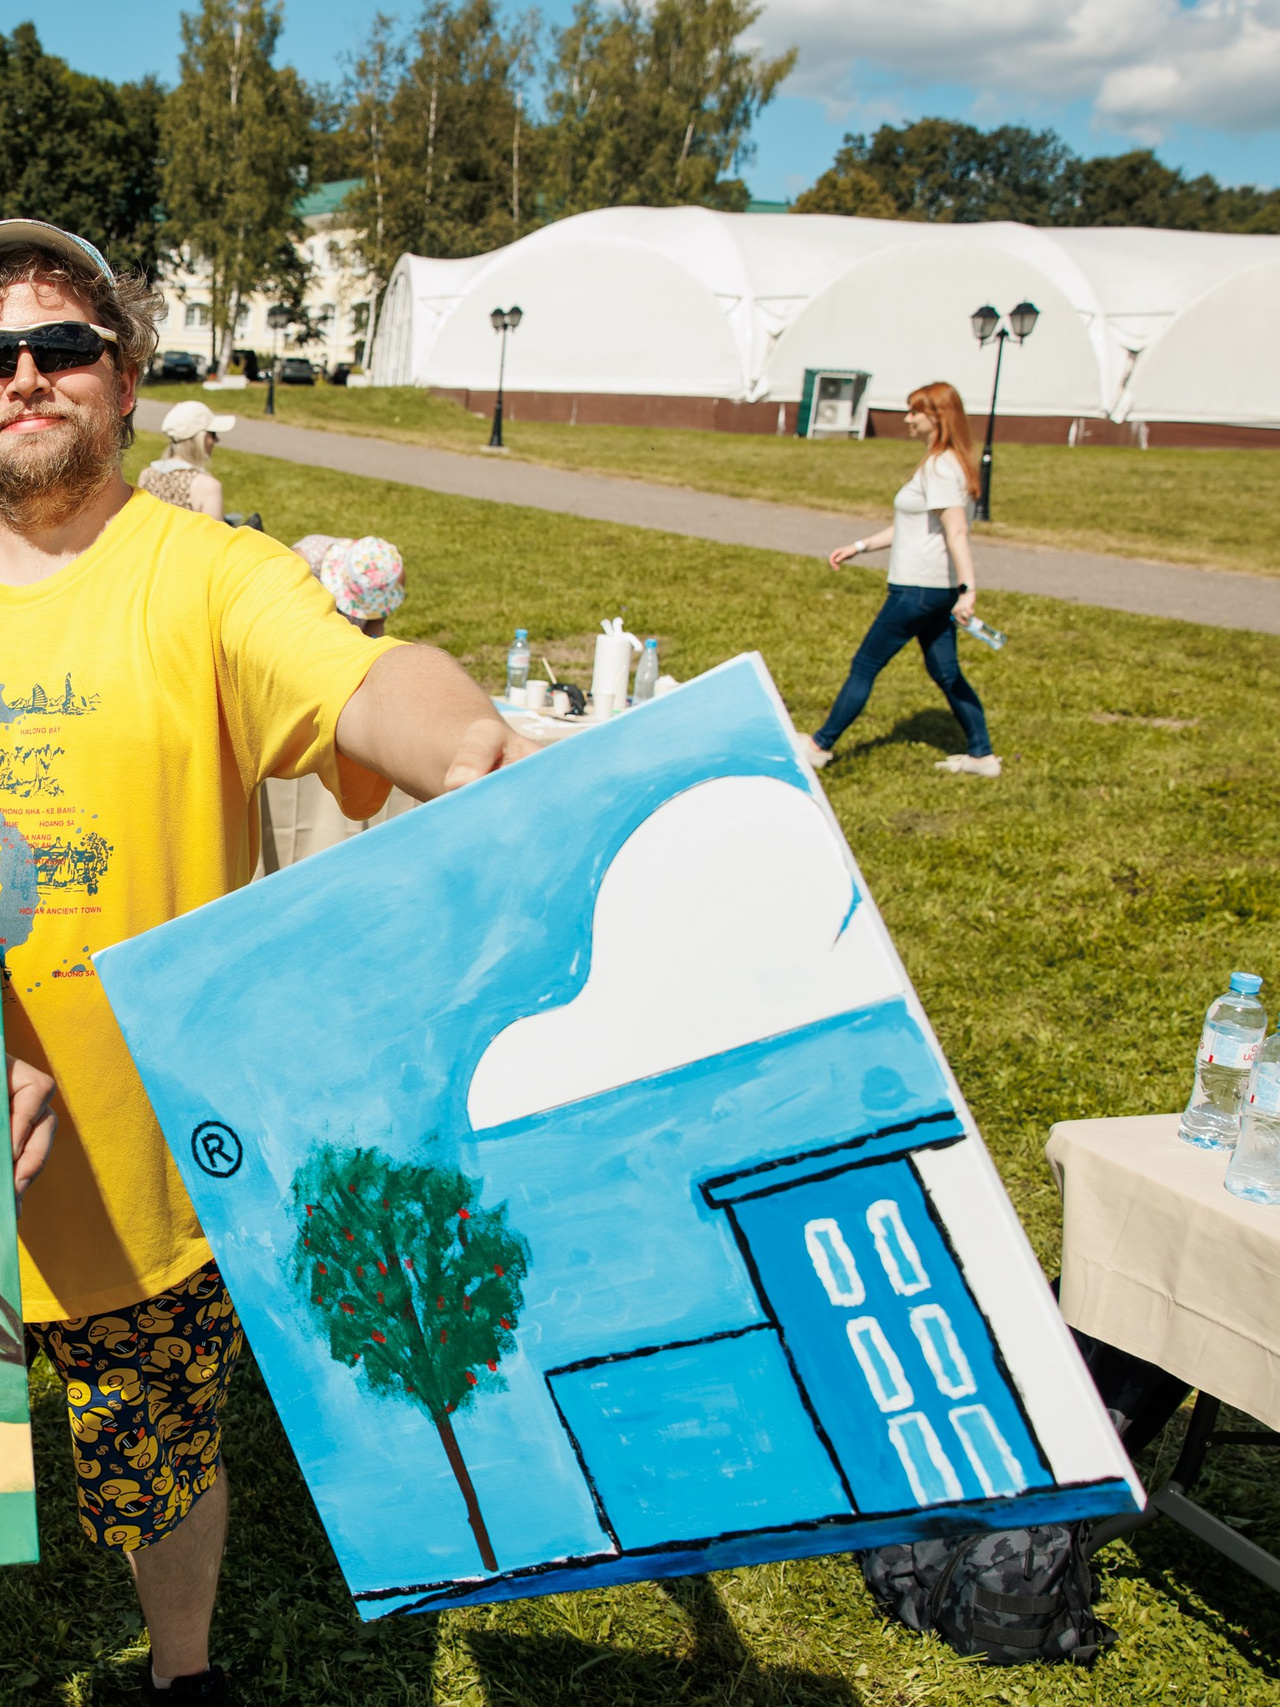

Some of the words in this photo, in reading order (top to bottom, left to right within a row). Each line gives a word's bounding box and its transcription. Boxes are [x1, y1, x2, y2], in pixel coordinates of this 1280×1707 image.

[20, 727, 47, 735] HALONG
[48, 726, 62, 734] BAY
[46, 807, 55, 815] KE
[56, 806, 76, 814] BANG
[39, 820, 64, 828] HOANG
[66, 819, 75, 827] SA
[19, 907, 33, 915] HOI
[34, 907, 45, 915] AN
[46, 907, 78, 915] ANCIENT
[80, 906, 102, 914] TOWN
[53, 970, 84, 978] TRUONG
[85, 969, 95, 977] SA
